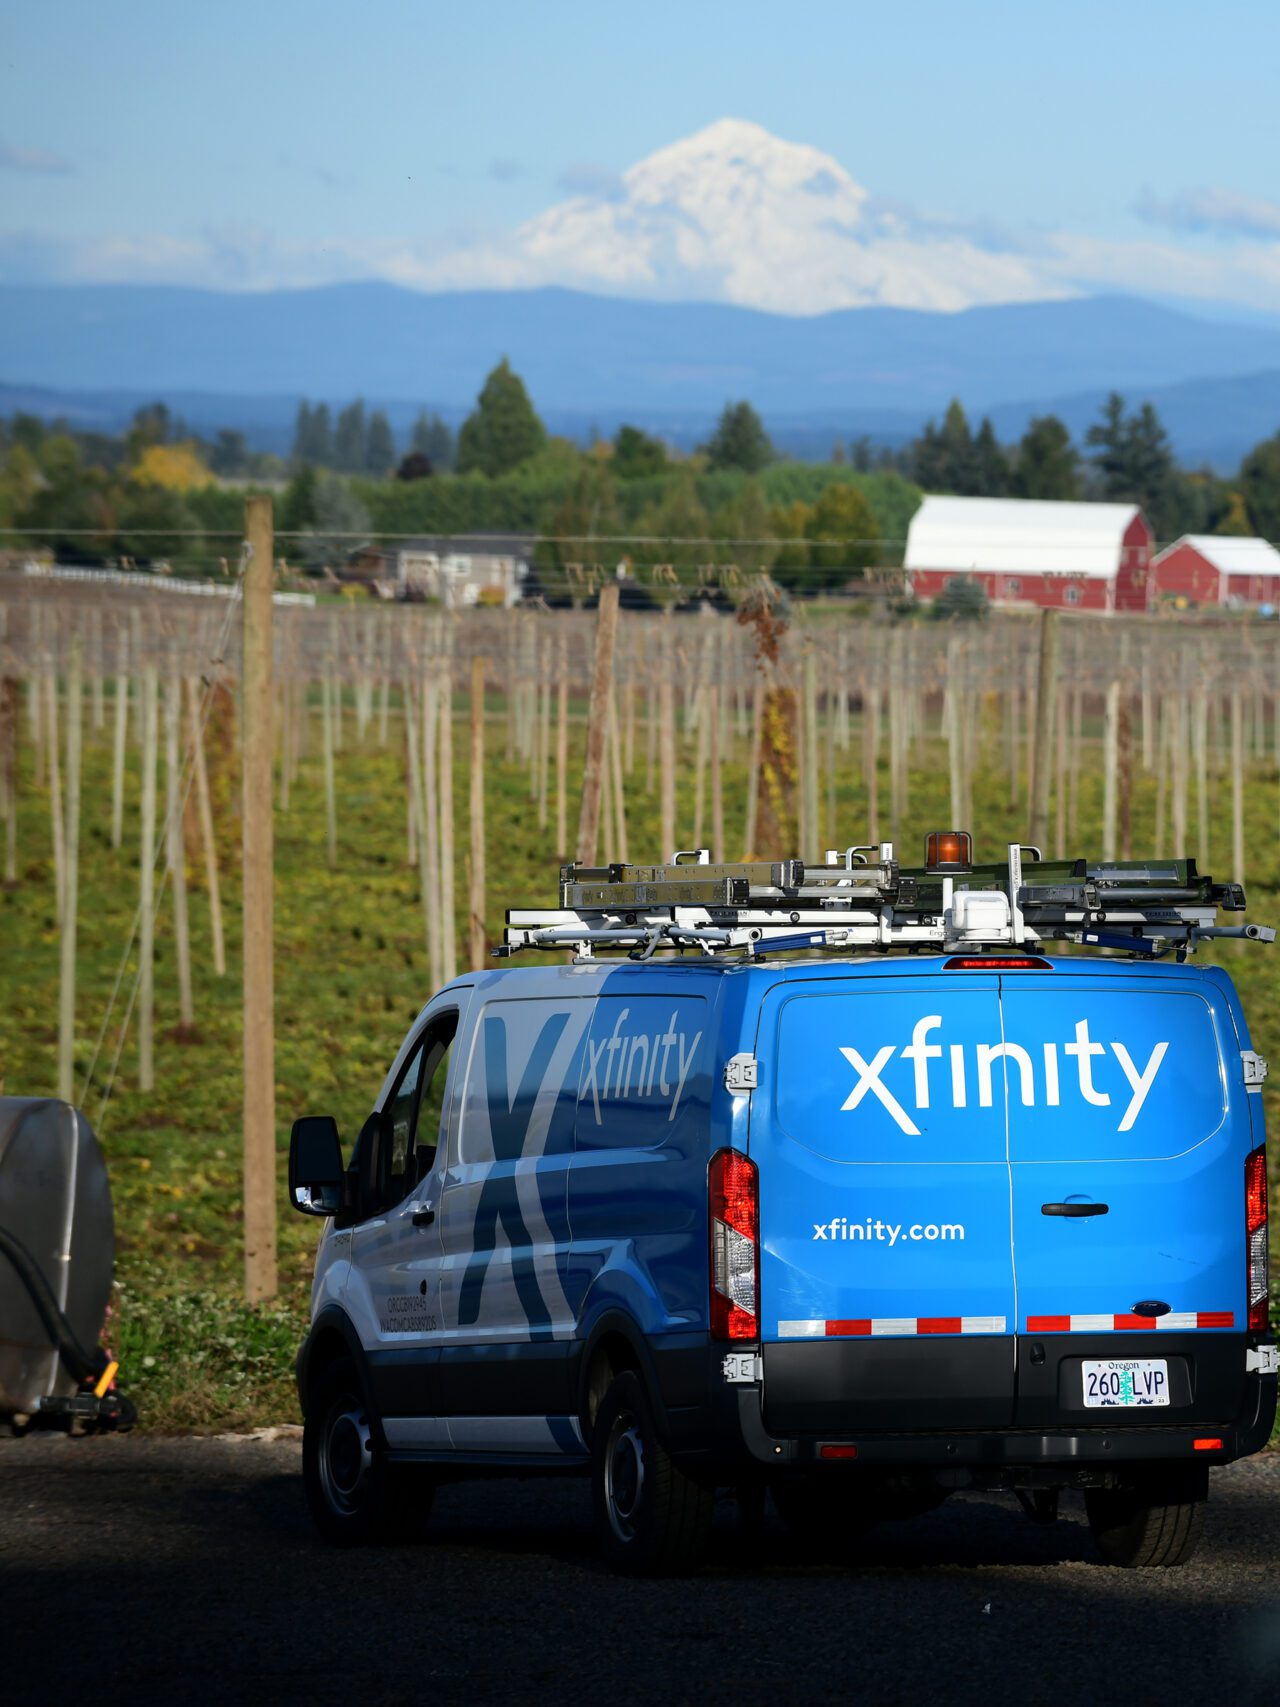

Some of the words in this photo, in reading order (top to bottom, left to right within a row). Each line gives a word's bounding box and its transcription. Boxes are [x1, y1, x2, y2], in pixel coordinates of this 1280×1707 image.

[580, 1007, 703, 1126] xfinity
[838, 1014, 1170, 1136] xfinity
[812, 1216, 966, 1246] xfinity.com
[1108, 1361, 1140, 1371] Oregon
[1087, 1372, 1120, 1396] 260
[1132, 1371, 1165, 1396] LVP
